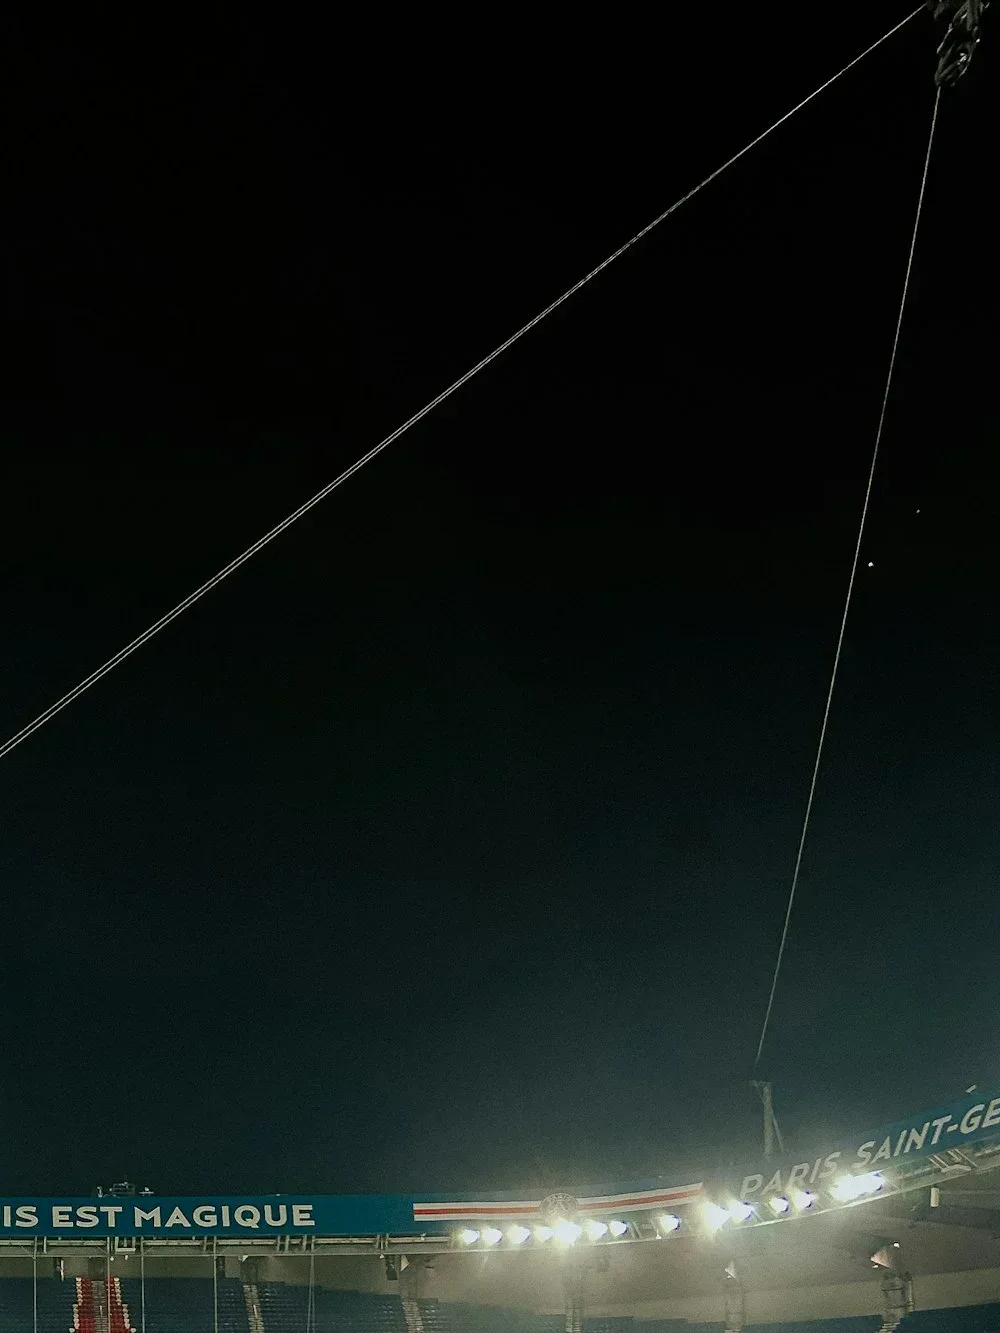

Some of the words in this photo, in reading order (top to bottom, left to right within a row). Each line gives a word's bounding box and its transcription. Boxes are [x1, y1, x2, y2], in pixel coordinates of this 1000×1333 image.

[739, 1151, 841, 1200] PARIS
[851, 1097, 1000, 1168] SAINT-GE
[52, 1204, 123, 1228] EST
[134, 1204, 316, 1228] MAGIQUE
